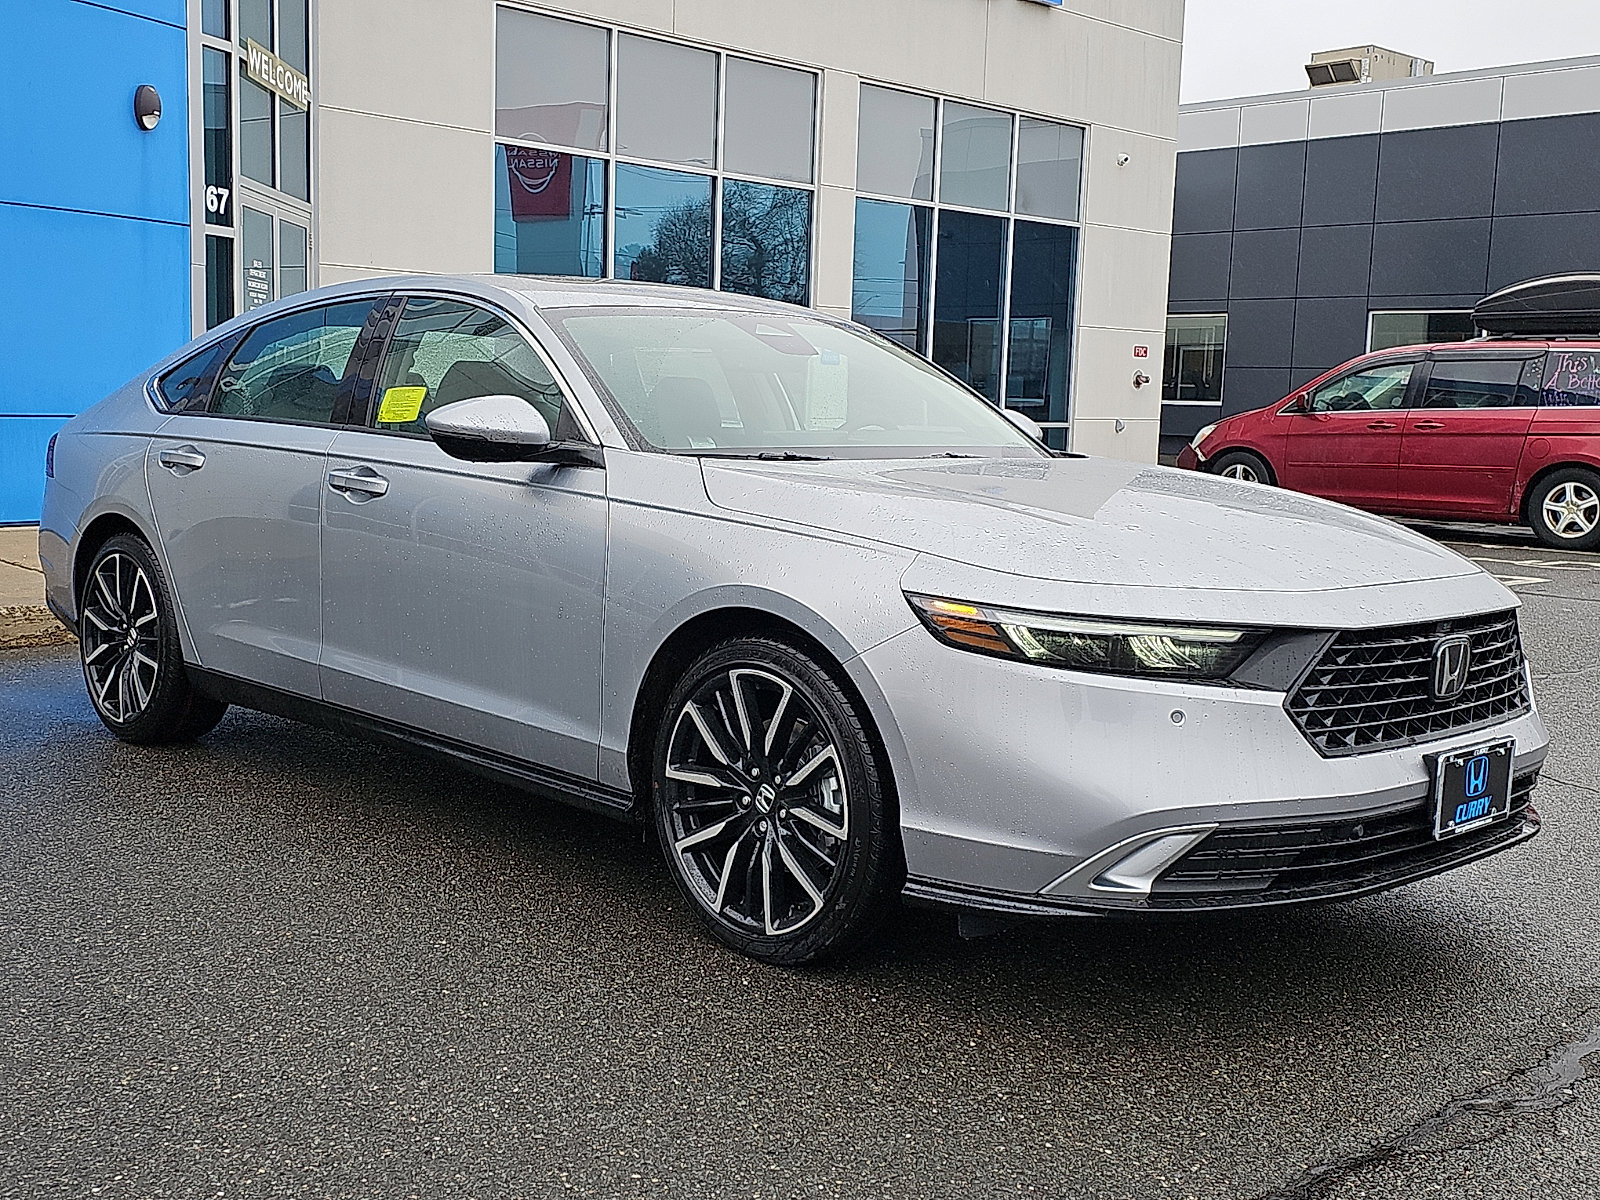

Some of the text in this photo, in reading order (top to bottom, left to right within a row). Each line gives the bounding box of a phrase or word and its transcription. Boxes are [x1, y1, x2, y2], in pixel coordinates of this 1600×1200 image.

[248, 43, 307, 104] WELCOME
[203, 184, 229, 215] 67
[1135, 347, 1147, 357] FDC
[1553, 352, 1588, 373] This
[1455, 796, 1492, 824] CURRY
